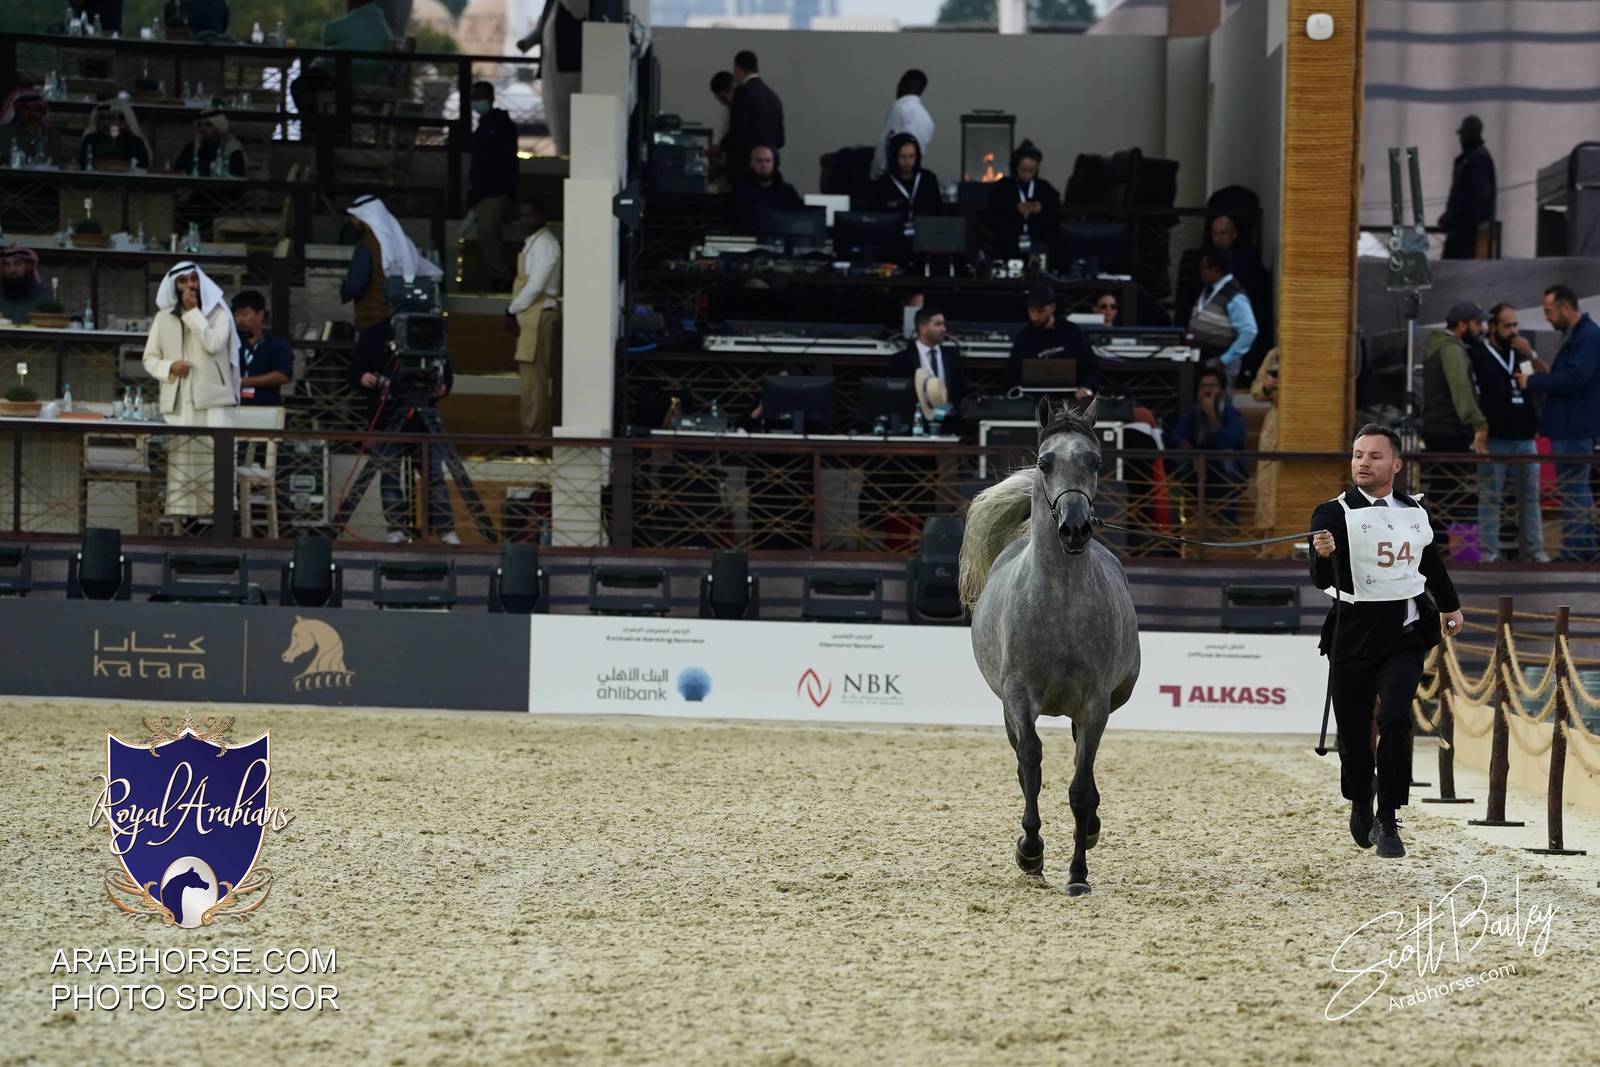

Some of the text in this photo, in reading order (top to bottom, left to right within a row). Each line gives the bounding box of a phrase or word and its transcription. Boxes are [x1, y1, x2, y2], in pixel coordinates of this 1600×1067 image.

[1377, 541, 1414, 568] 54
[93, 655, 206, 679] katara
[596, 685, 667, 701] ahlibank
[843, 673, 902, 695] NBK
[1188, 685, 1287, 705] ALKASS
